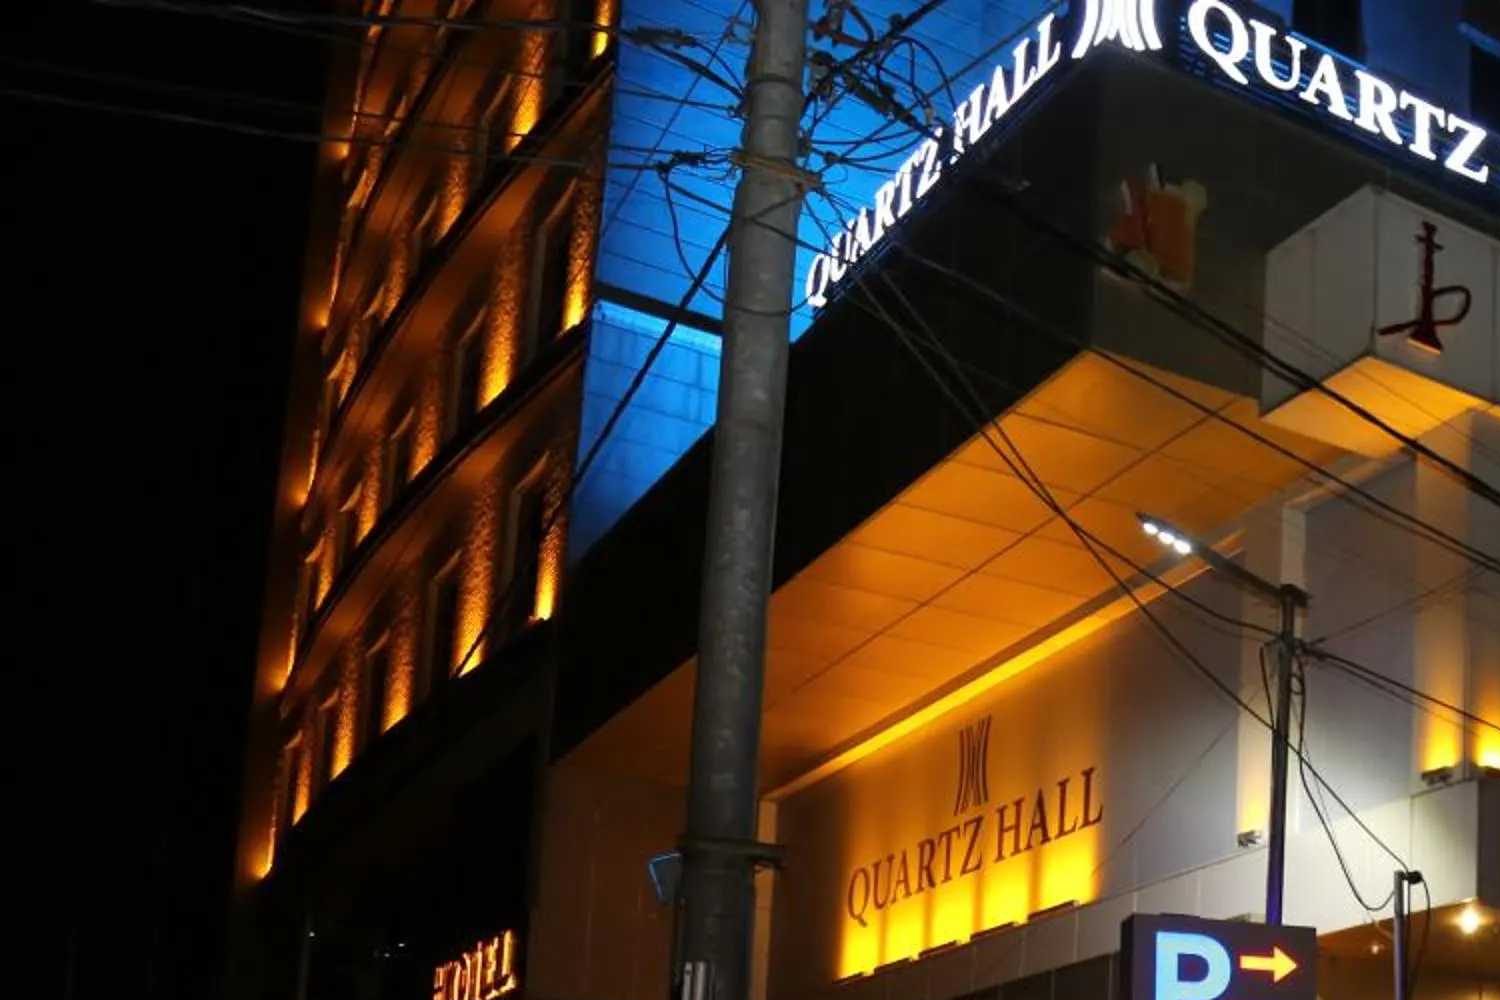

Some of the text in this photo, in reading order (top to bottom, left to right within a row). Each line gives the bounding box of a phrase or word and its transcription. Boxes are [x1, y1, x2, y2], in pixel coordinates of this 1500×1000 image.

[805, 12, 1061, 307] QUARTZ HALL
[1187, 0, 1489, 184] QUARTZ
[847, 766, 1103, 927] QUARTZ HALL
